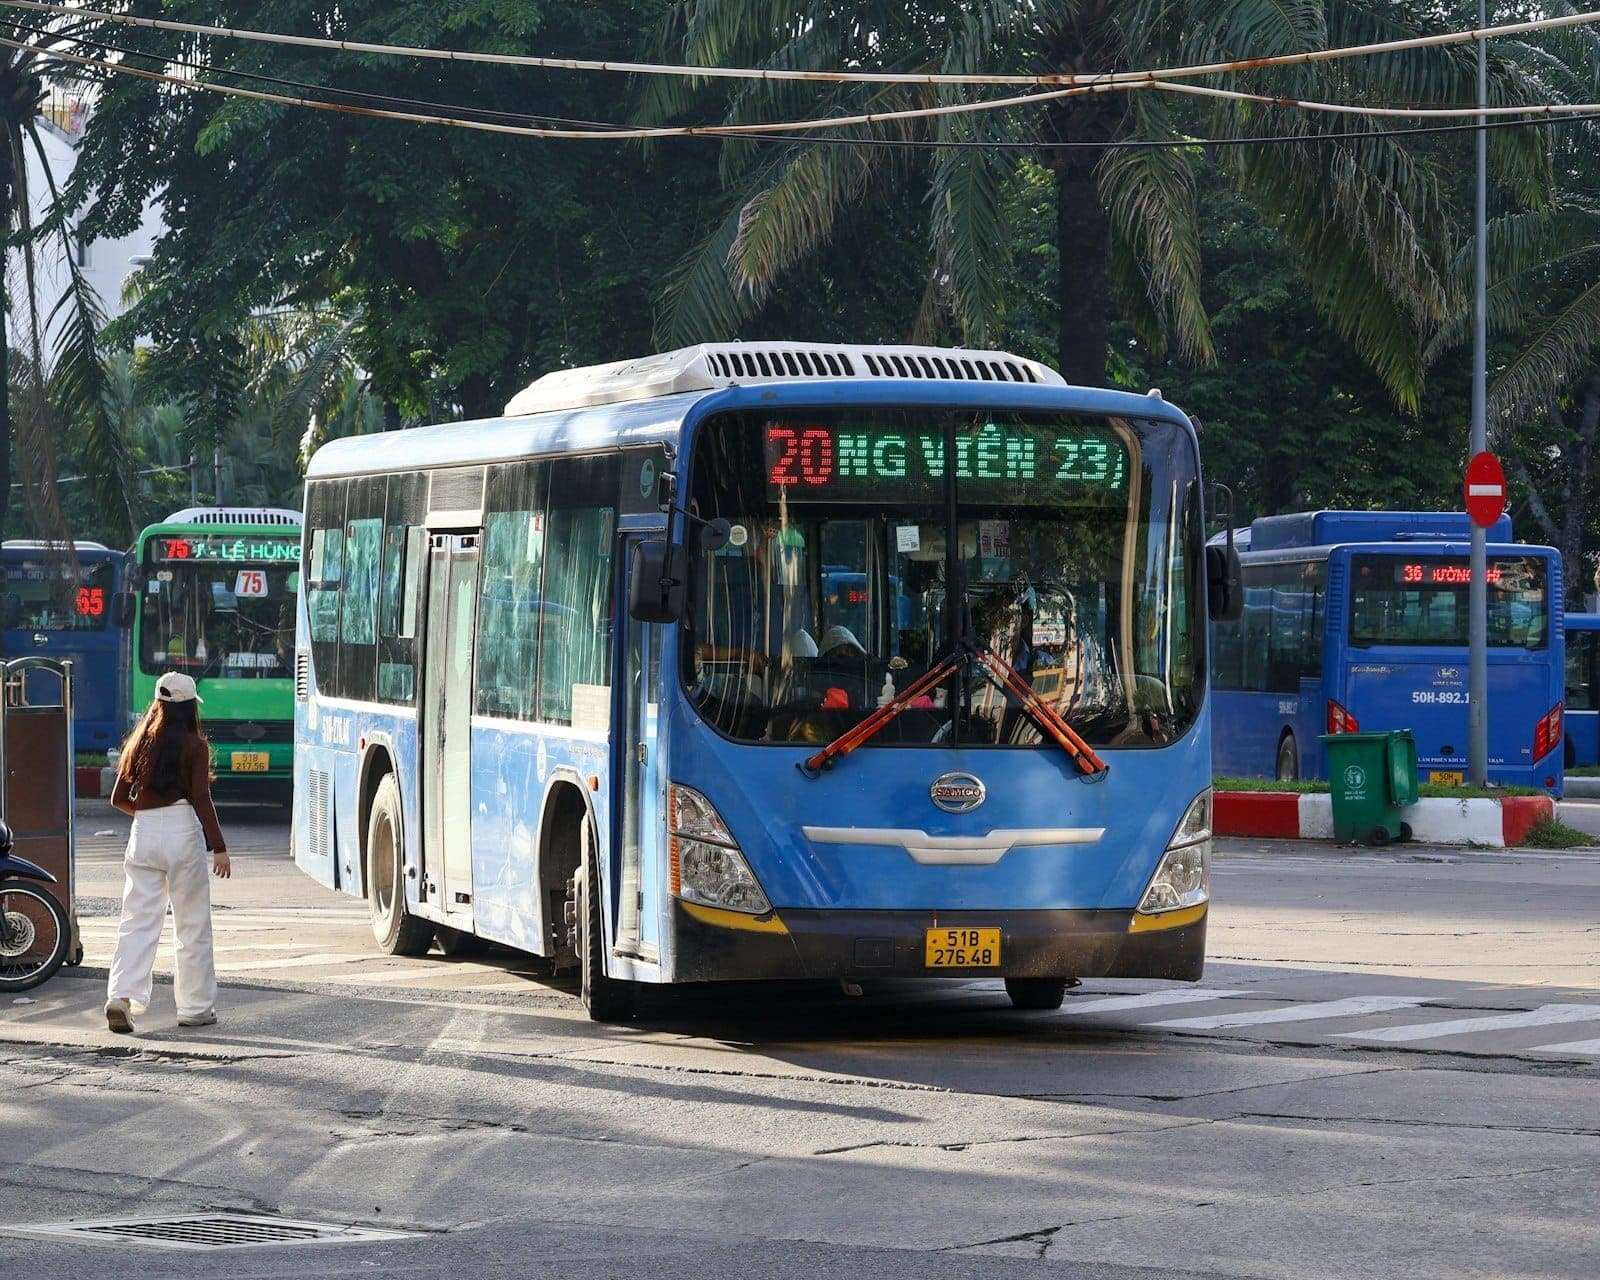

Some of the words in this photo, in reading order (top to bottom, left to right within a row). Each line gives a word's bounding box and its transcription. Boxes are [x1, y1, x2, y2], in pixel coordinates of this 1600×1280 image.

[768, 429, 832, 484] 20
[839, 435, 906, 476] NG
[920, 423, 1034, 478] VIÊN
[166, 539, 189, 559] 75
[1404, 565, 1422, 582] 36
[242, 572, 262, 594] 75
[76, 587, 104, 616] 65
[1438, 772, 1454, 781] 50H
[936, 786, 981, 797] SAMCO
[947, 931, 979, 946] 51B
[934, 949, 992, 965] 276.48
